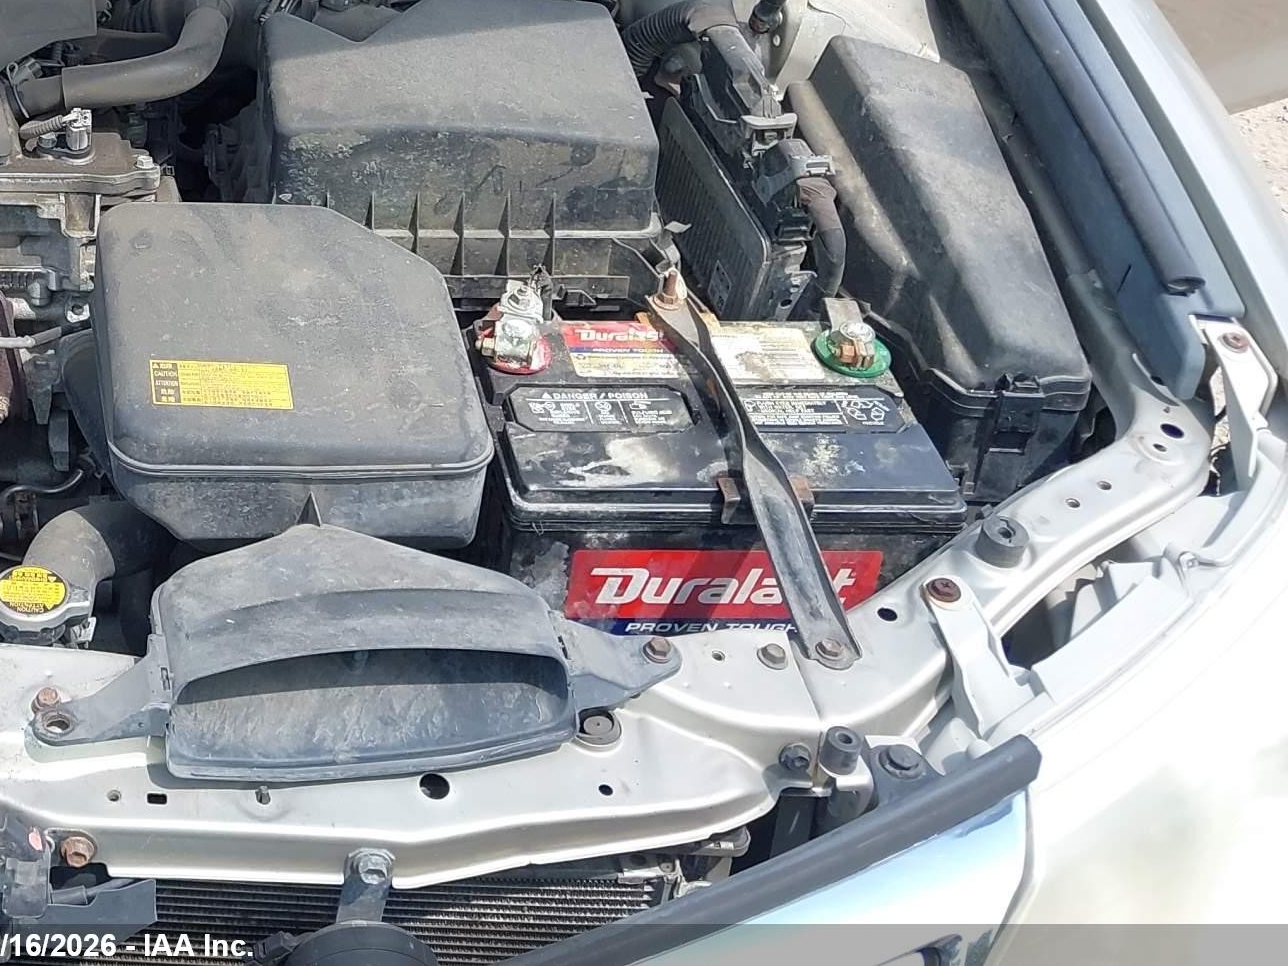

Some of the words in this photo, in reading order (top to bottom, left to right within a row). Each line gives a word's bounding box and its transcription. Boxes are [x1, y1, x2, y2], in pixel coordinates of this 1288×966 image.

[553, 392, 598, 400] DANGER
[607, 392, 648, 400] POISON
[590, 567, 856, 605] Duralat
[624, 622, 719, 633] PROVEN
